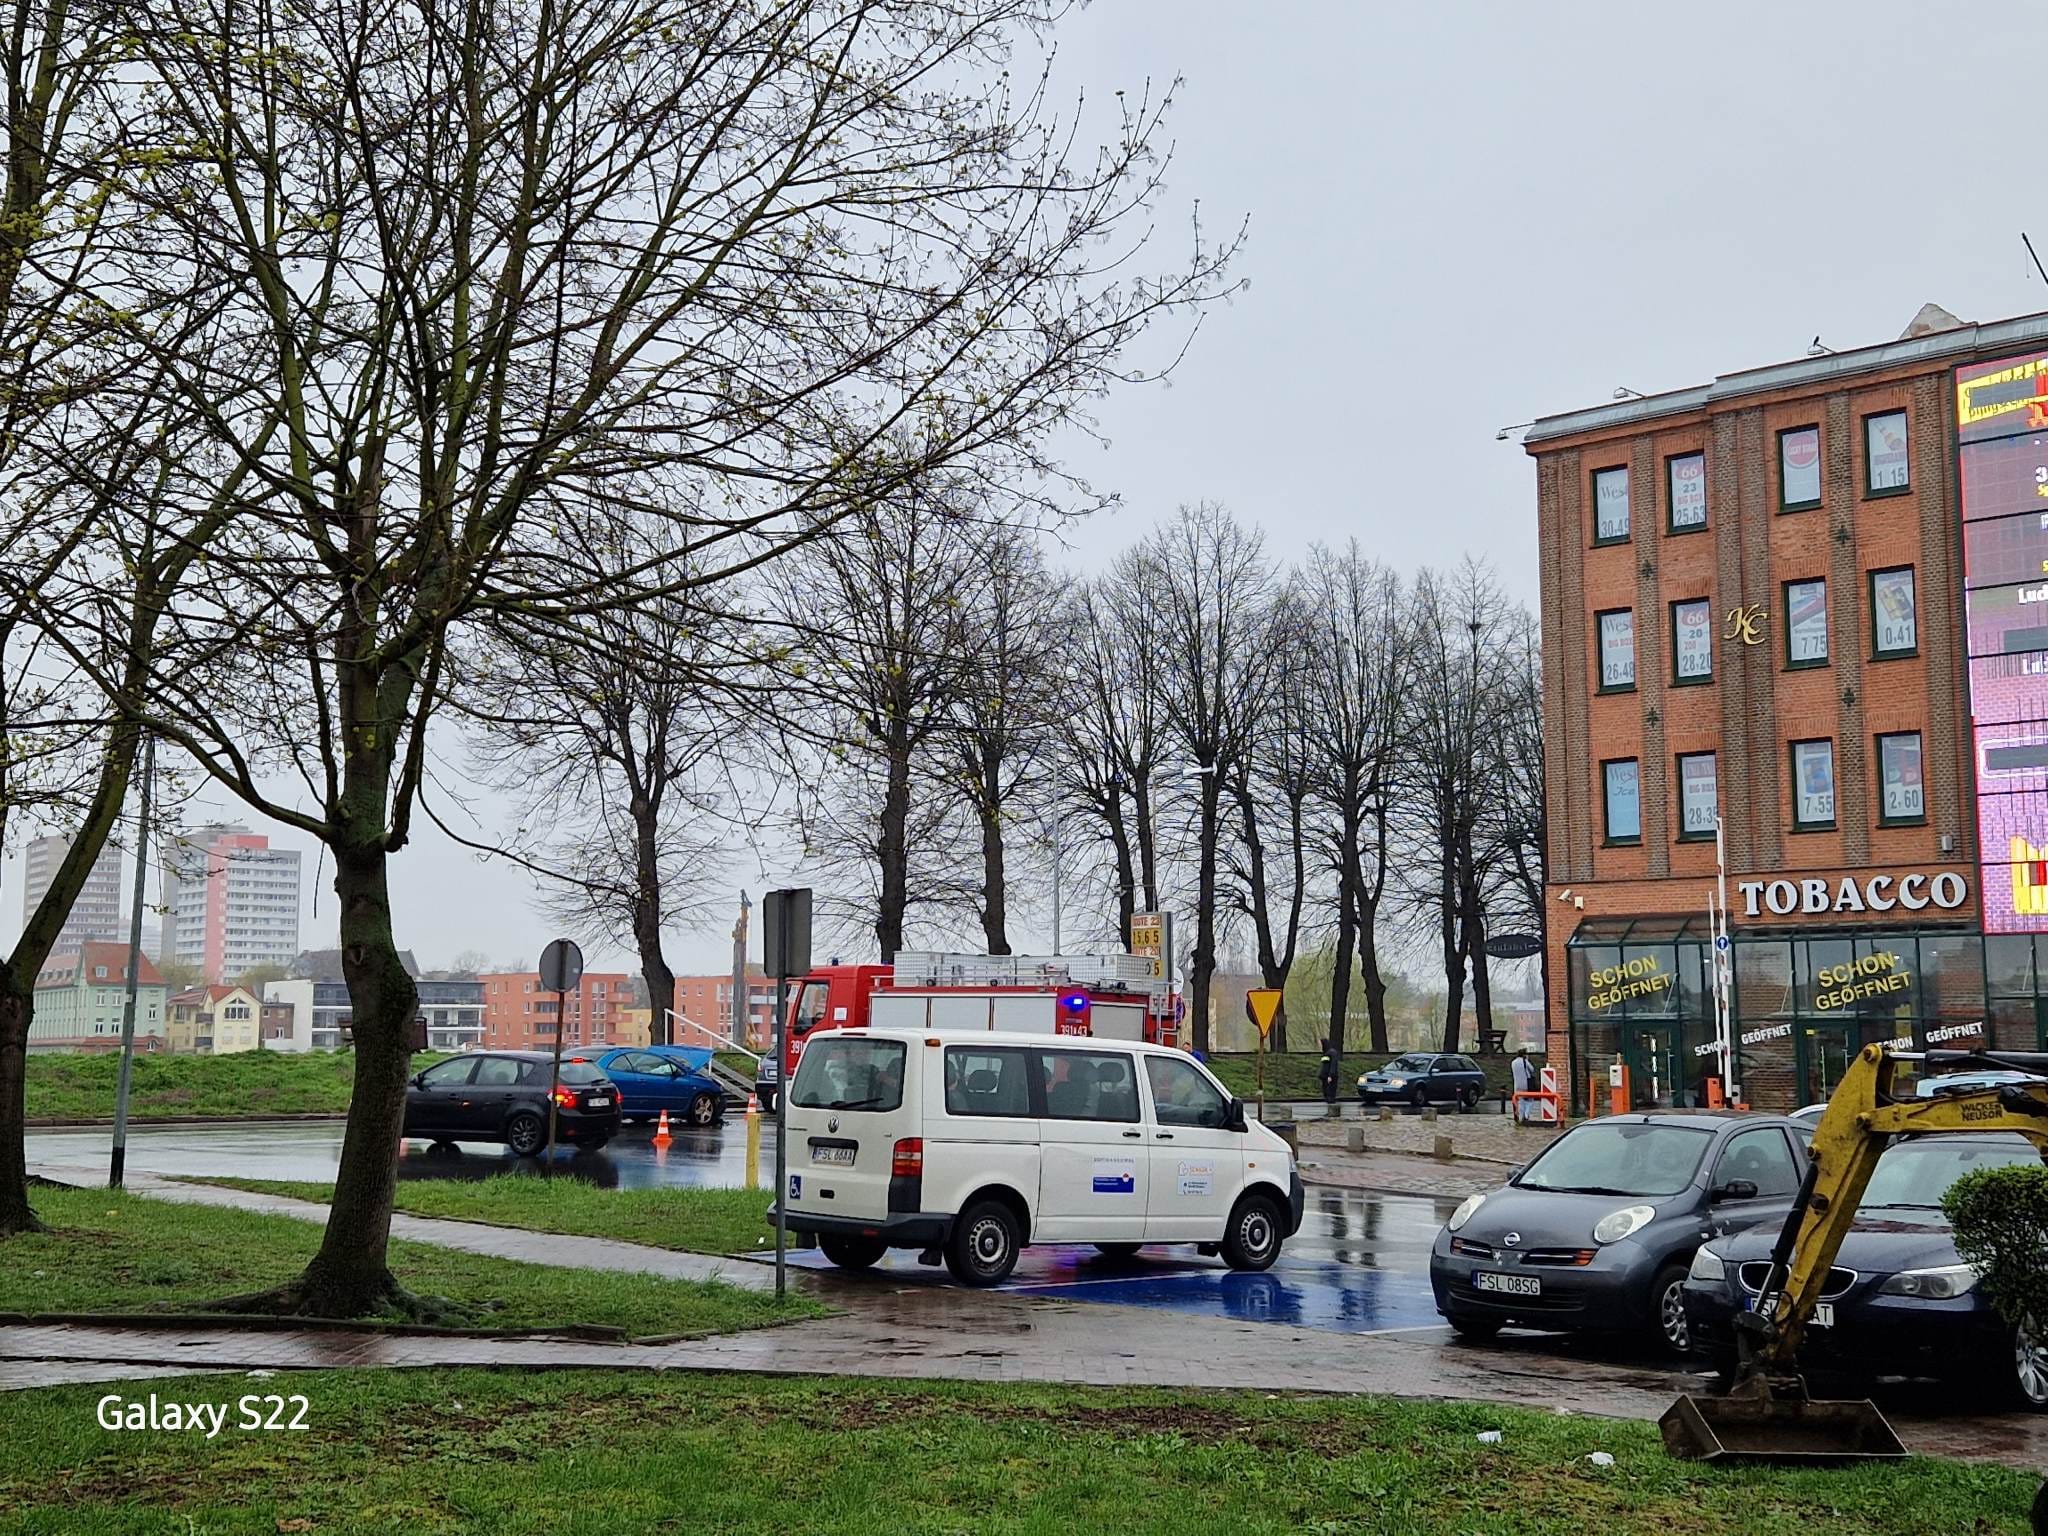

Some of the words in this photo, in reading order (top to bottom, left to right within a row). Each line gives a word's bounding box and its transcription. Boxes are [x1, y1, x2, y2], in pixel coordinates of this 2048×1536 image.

[1681, 465, 1698, 478] 66
[1682, 483, 1697, 493] 23
[1687, 611, 1704, 624] 66
[1689, 629, 1703, 639] 20
[1739, 872, 1967, 915] TOBACCO
[1590, 954, 1657, 988] SCHON
[1818, 951, 1896, 988] SCHON
[1587, 973, 1671, 1010] GEÖFFNET
[1815, 971, 1912, 1011] GEÖFFNET
[1741, 1023, 1792, 1046] GEÖFFNET
[1925, 1021, 1984, 1044] GEÖFFNET
[1962, 1110, 2003, 1121] NEUSON
[1479, 1274, 1503, 1291] FSL
[1507, 1277, 1539, 1294] 08SG
